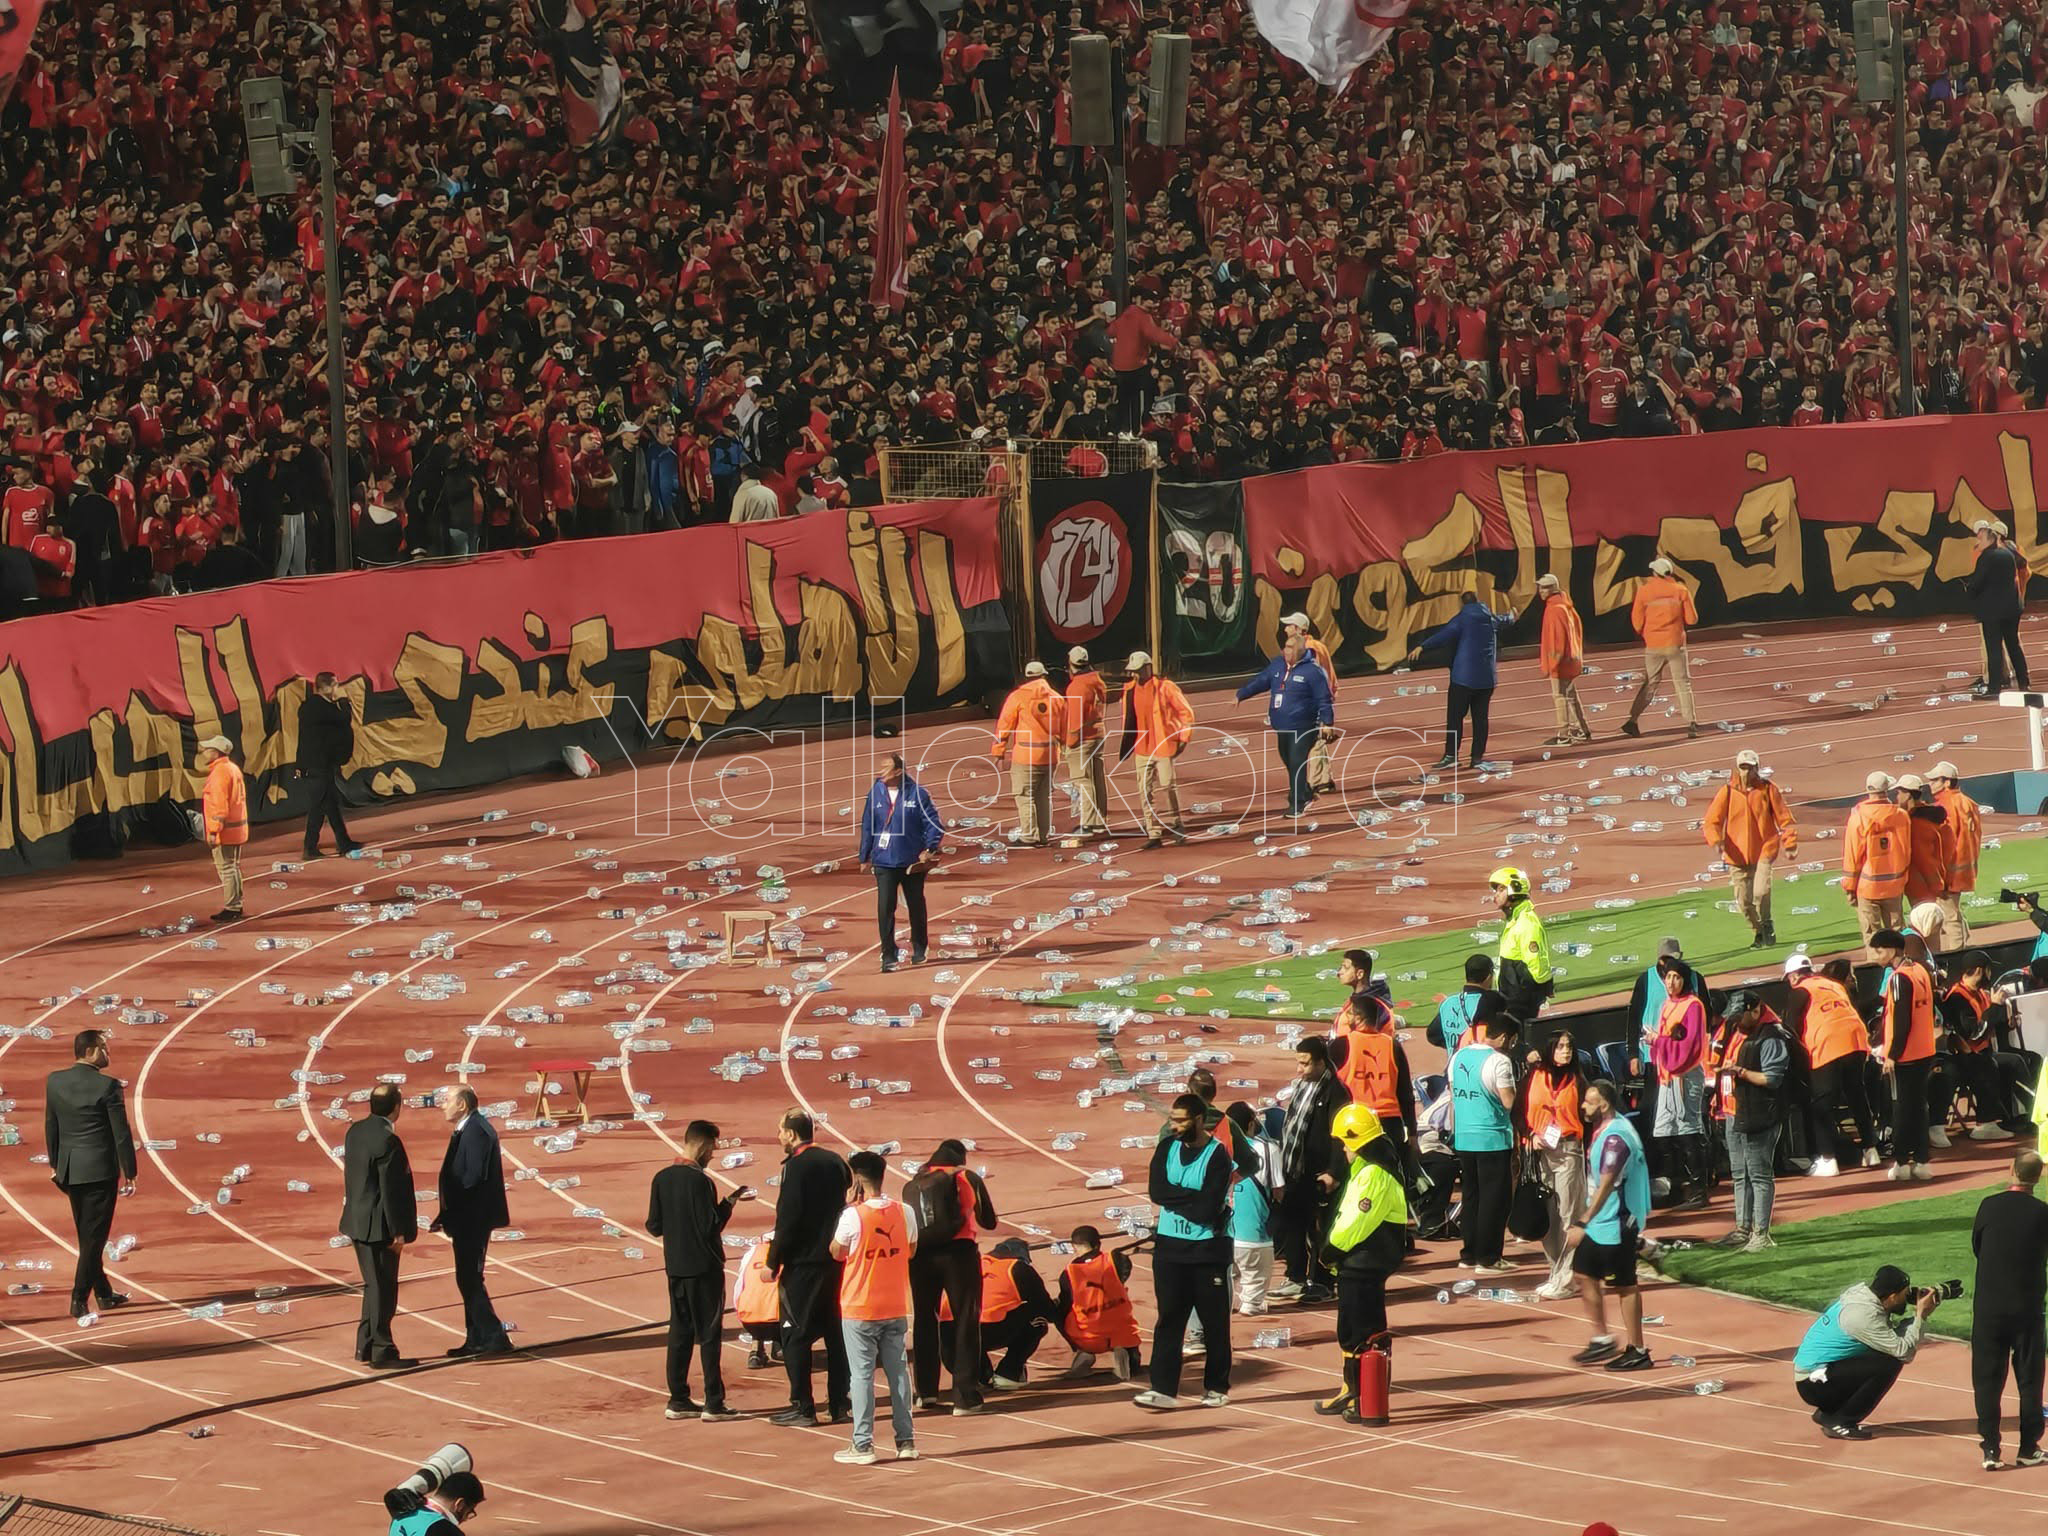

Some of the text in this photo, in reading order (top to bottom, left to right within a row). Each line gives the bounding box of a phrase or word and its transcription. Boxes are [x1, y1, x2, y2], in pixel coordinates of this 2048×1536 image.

[1823, 430, 2048, 612] ادي
[1165, 529, 1243, 623] 20
[1254, 466, 1572, 672] الكون
[1354, 1070, 1388, 1081] CAF
[1453, 1087, 1482, 1100] CAF
[1174, 1219, 1192, 1235] 116
[865, 1247, 900, 1260] CAF
